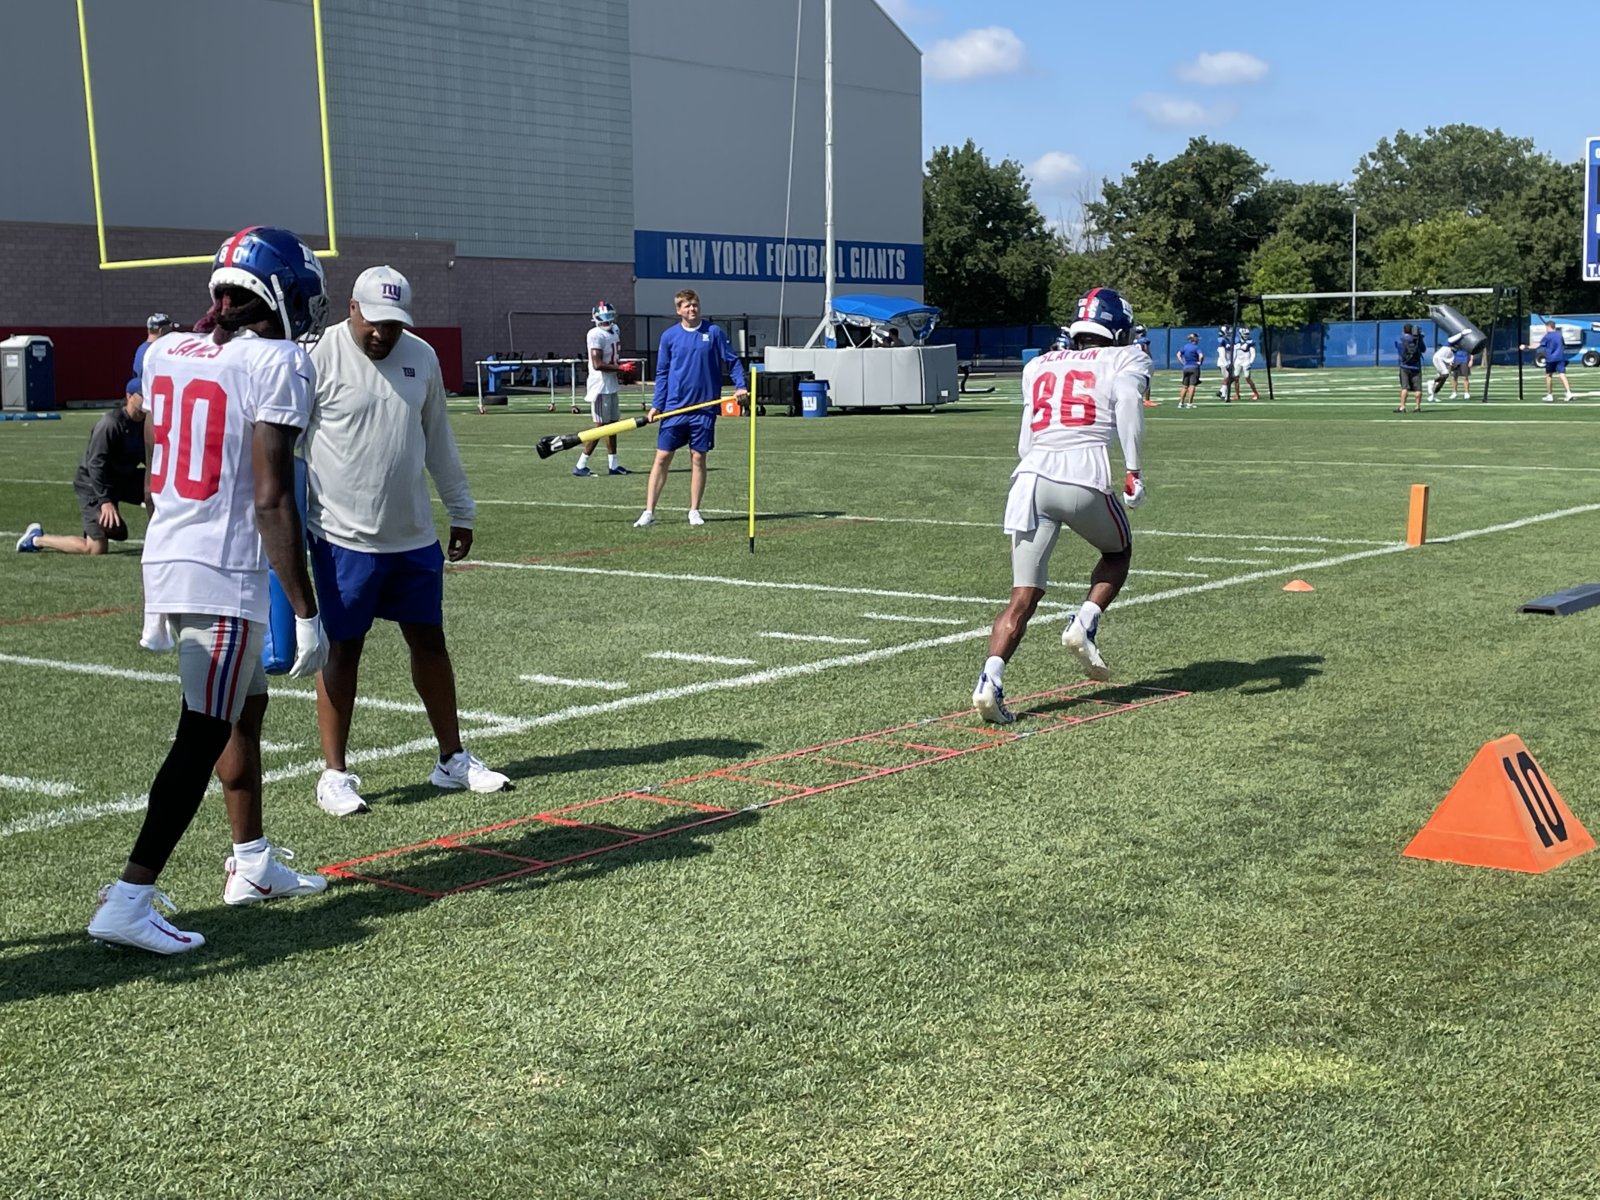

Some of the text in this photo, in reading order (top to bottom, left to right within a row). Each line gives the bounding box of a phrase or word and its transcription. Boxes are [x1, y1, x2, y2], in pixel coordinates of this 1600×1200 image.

[666, 238, 906, 280] NEW YORK FOOTBAL GIANTS
[725, 402, 735, 414] G
[1030, 369, 1097, 433] 86
[150, 375, 228, 501] 80
[1502, 751, 1568, 848] 10
